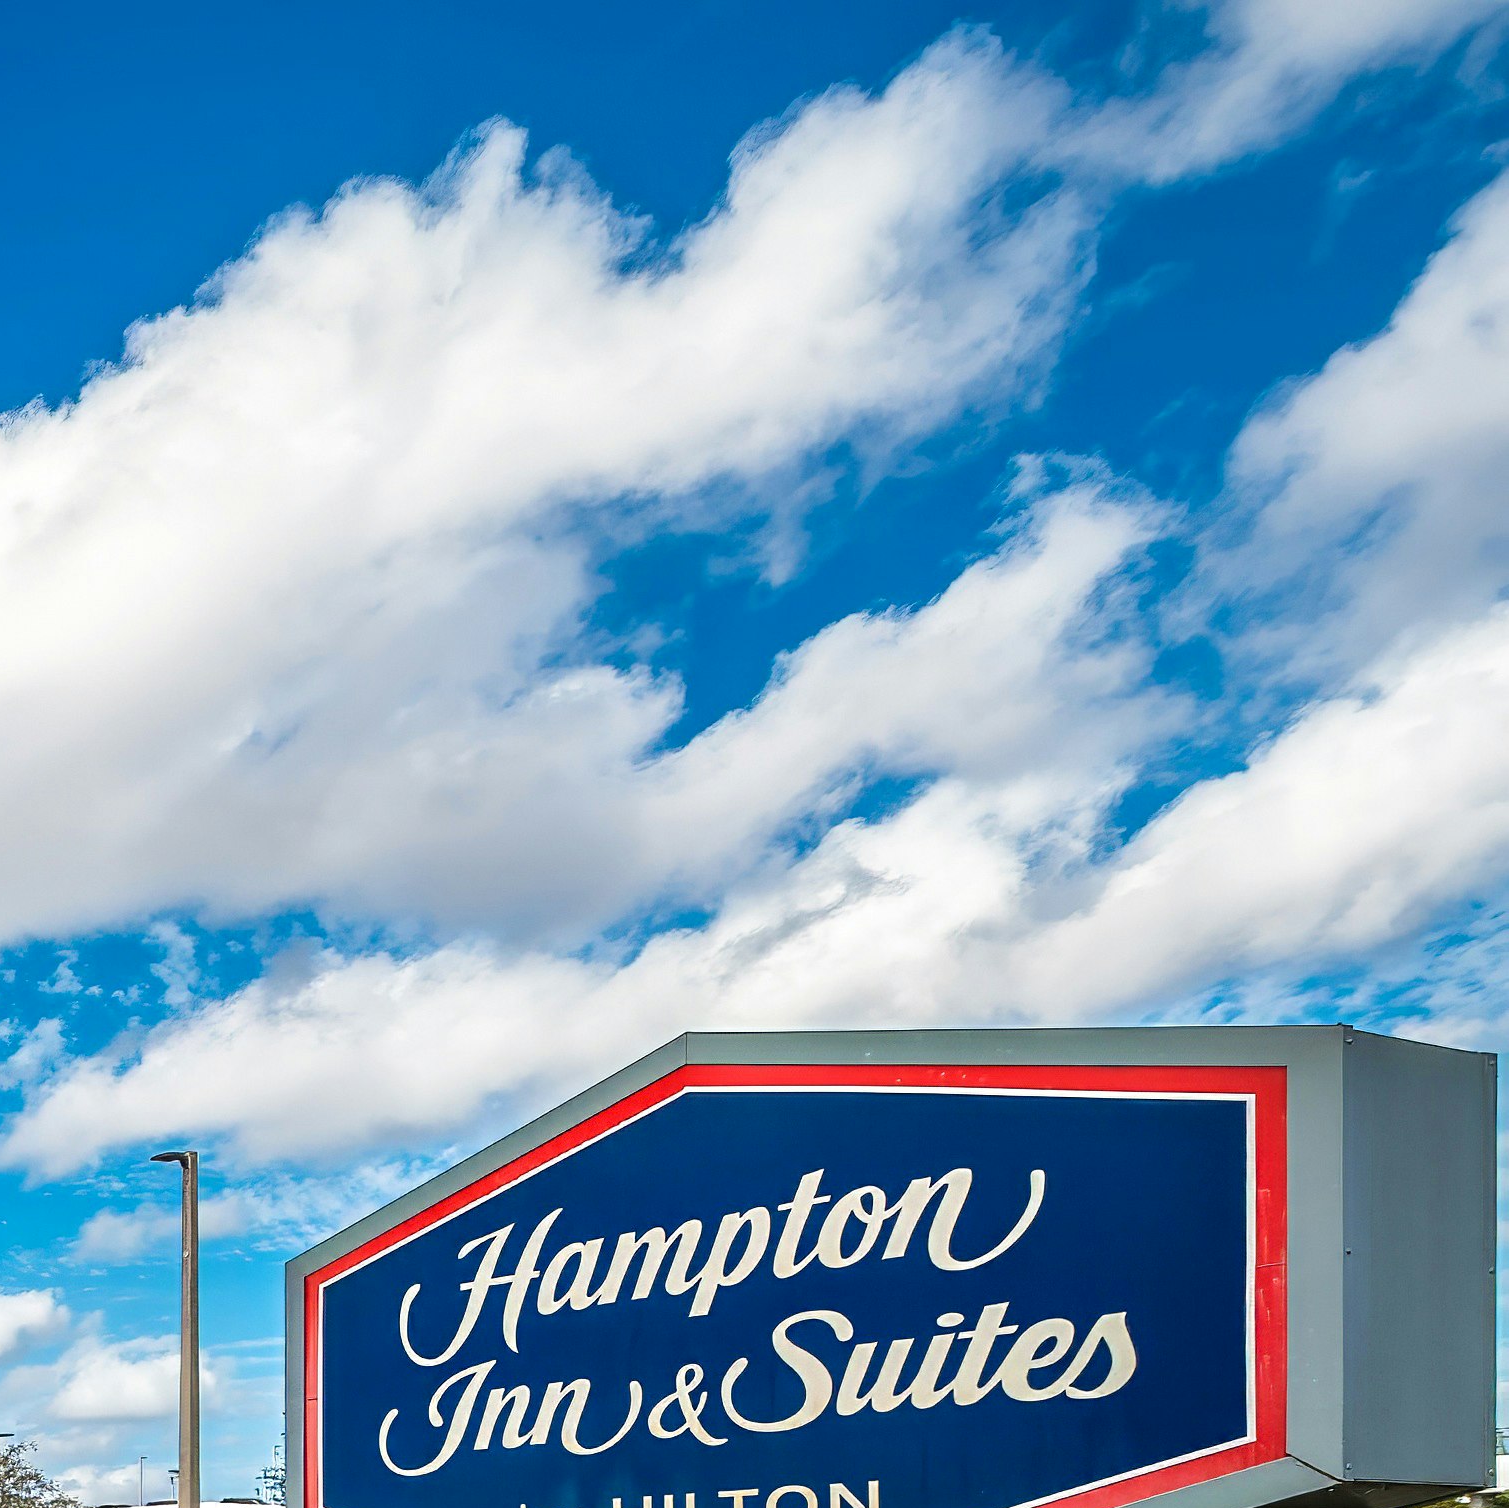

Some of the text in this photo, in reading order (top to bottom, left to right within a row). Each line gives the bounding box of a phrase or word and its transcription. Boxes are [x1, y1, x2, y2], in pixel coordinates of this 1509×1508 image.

[400, 1168, 1045, 1366] Hampton
[379, 1302, 1136, 1476] Inn & Suites
